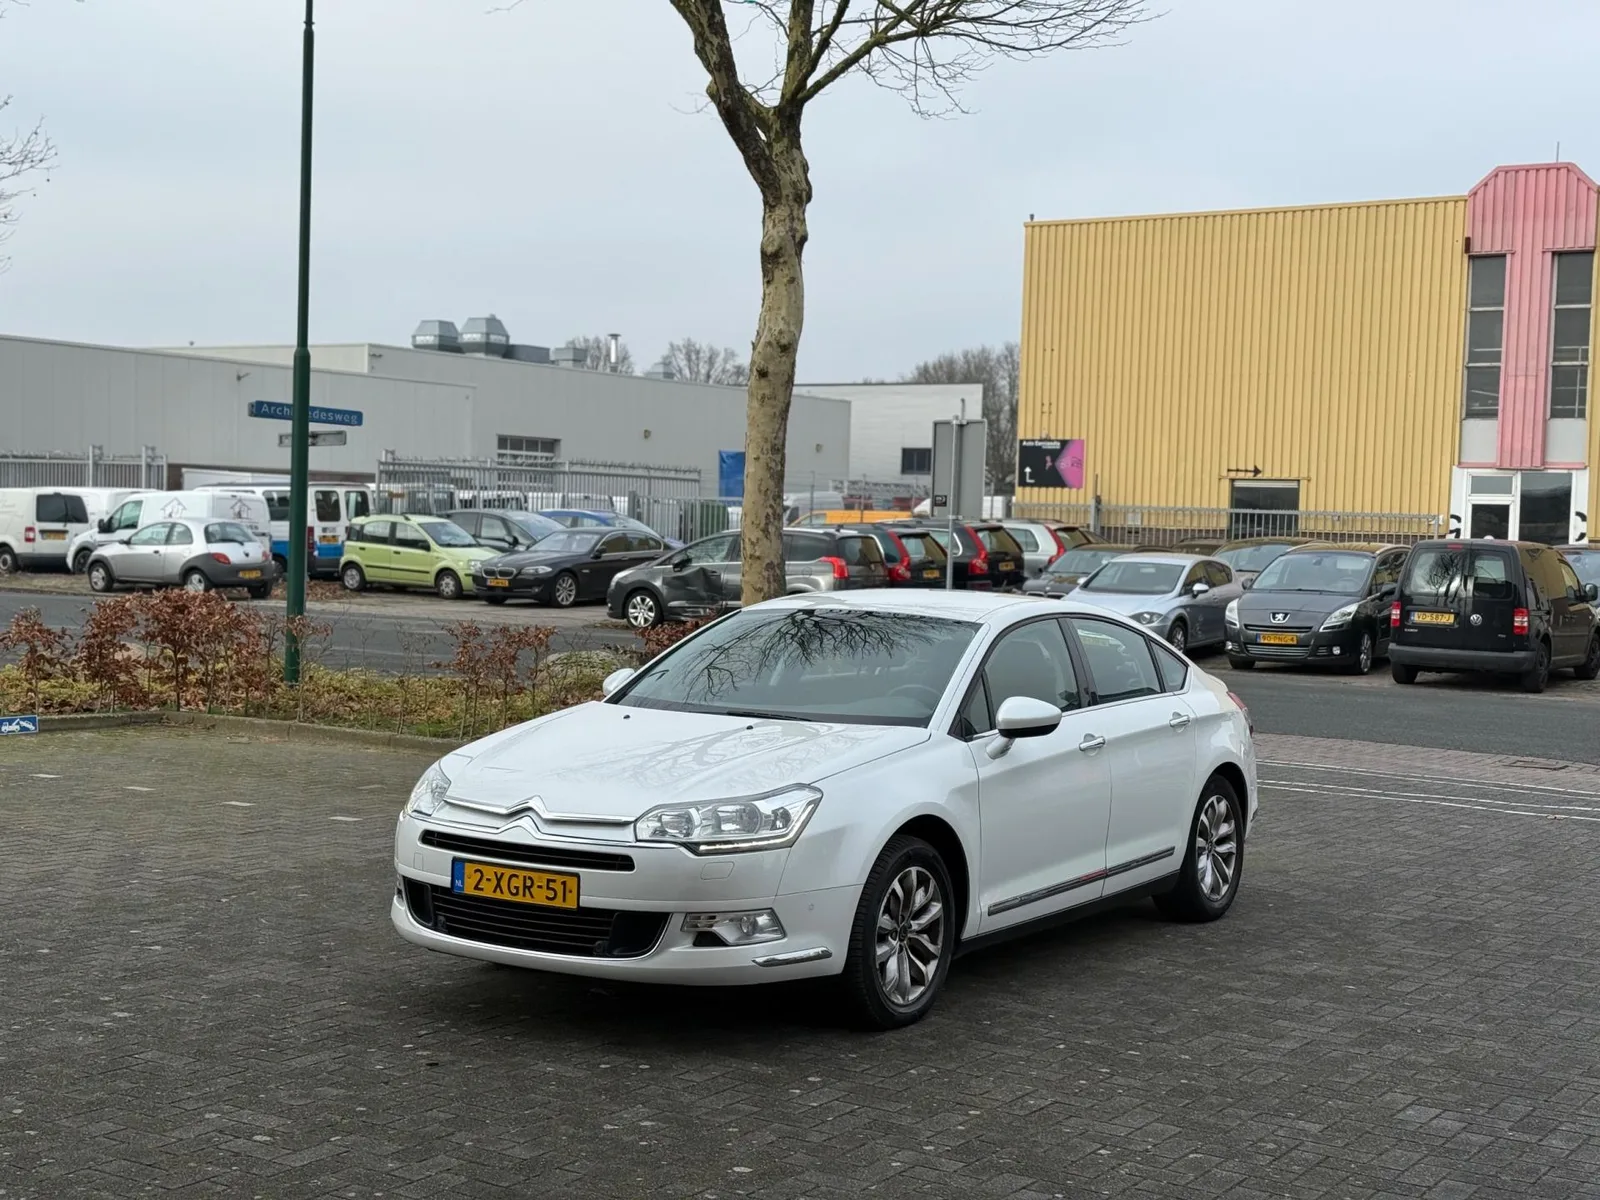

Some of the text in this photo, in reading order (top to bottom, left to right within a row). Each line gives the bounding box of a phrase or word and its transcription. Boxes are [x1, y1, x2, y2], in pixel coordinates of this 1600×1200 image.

[261, 403, 358, 424] Archidesweg
[1416, 613, 1451, 622] VD-587-J
[455, 868, 567, 903] NL 2-XGR-51
